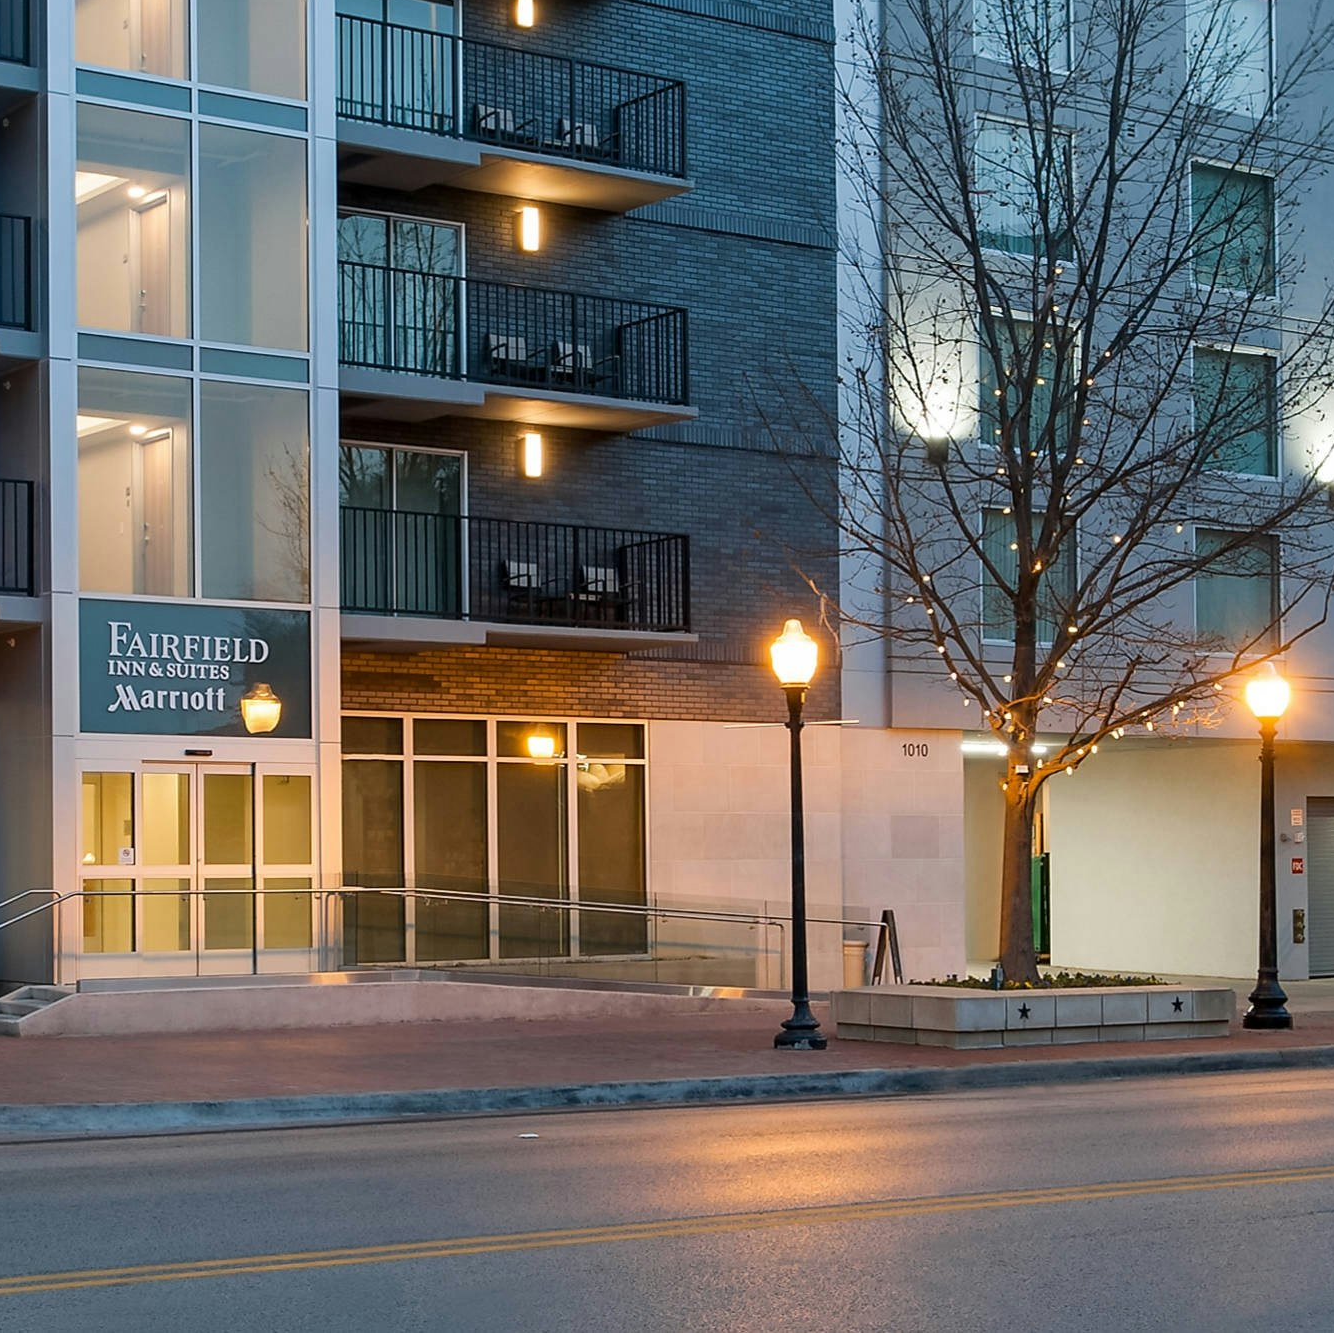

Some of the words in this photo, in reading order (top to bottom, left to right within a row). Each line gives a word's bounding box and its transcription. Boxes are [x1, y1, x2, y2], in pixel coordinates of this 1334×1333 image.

[107, 621, 269, 664] FAIRFIELD
[107, 660, 146, 676] INN
[148, 661, 164, 678] &
[165, 663, 230, 680] SUITES
[107, 683, 226, 713] Marriott
[902, 743, 929, 757] 1010
